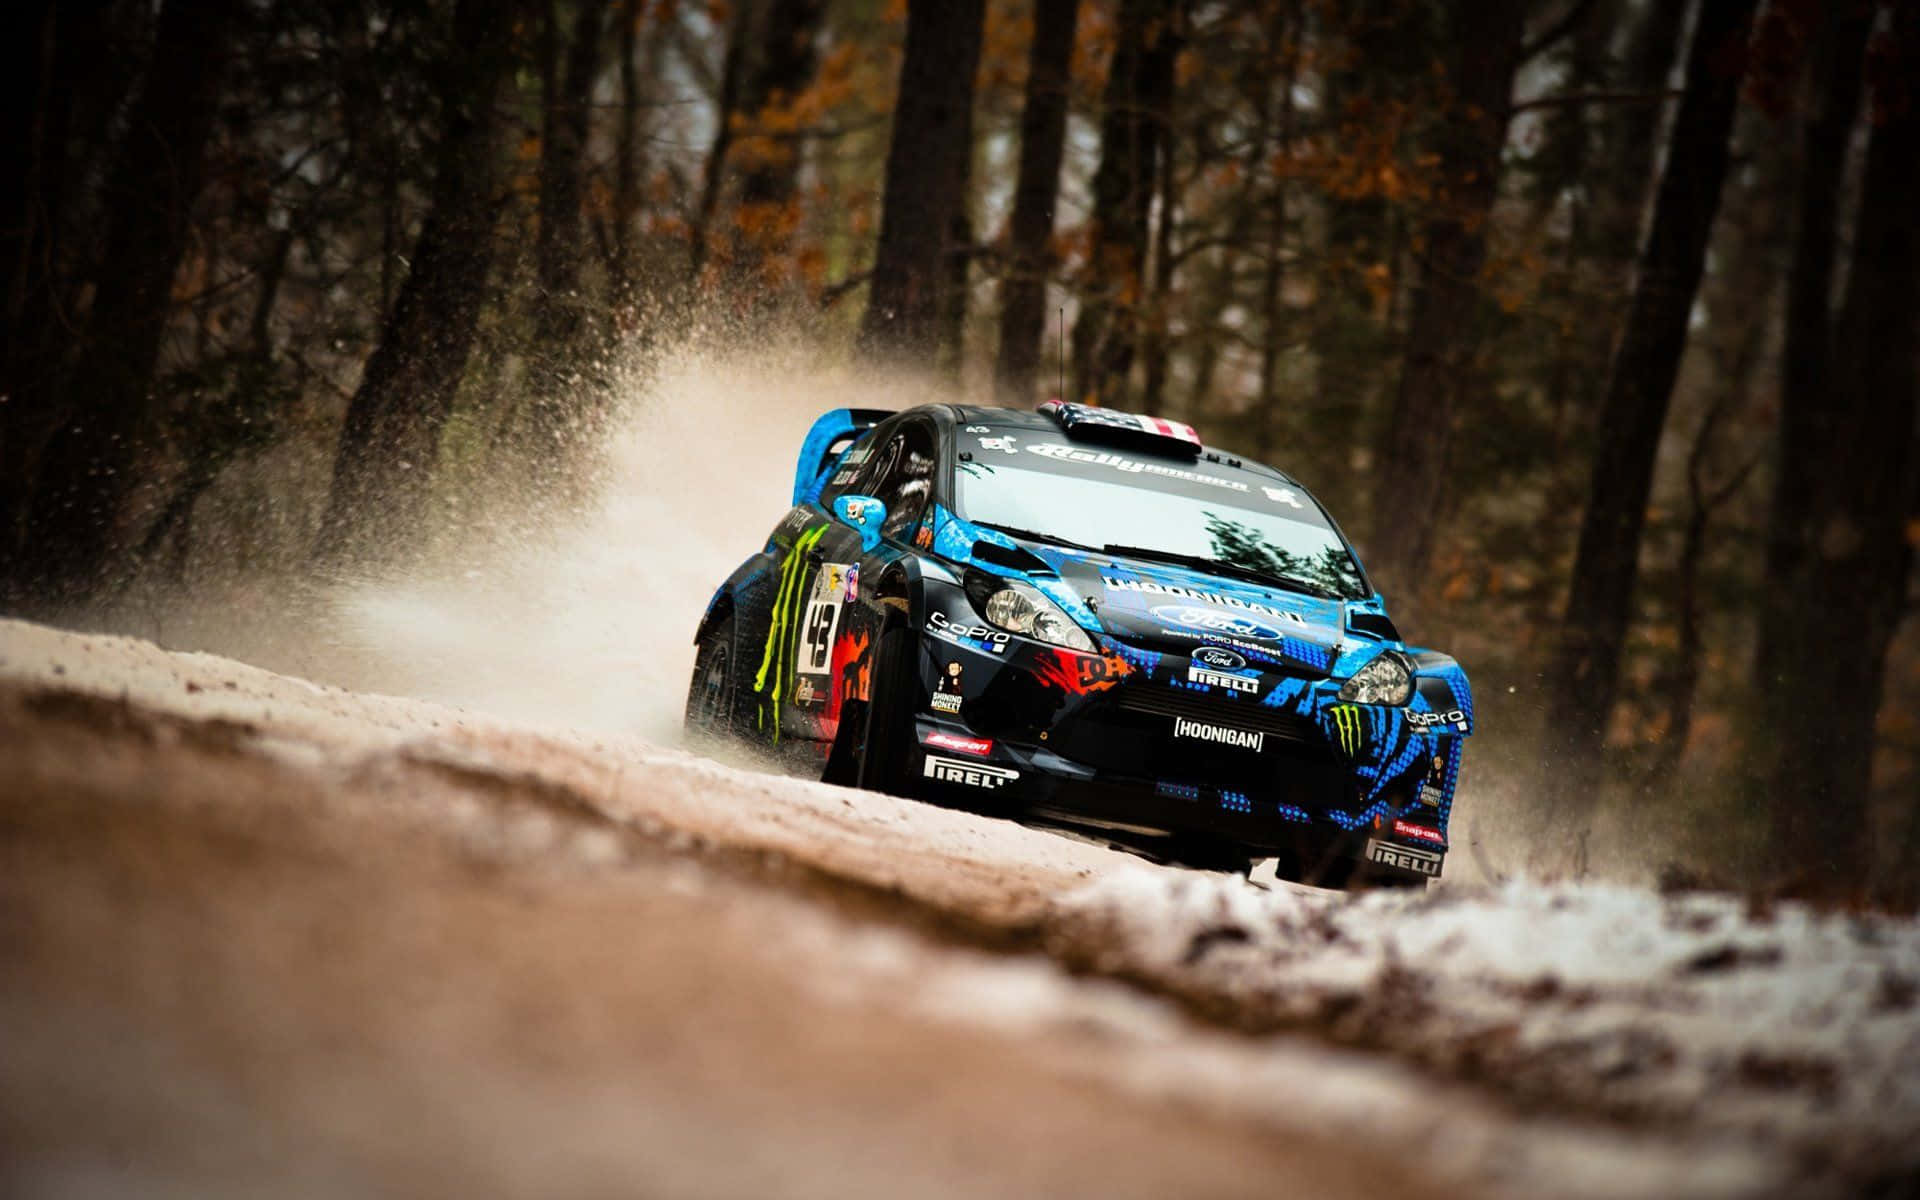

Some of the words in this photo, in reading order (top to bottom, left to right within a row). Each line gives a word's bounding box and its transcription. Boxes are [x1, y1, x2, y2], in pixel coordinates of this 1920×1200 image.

[930, 611, 1010, 643] GoPro
[1179, 606, 1257, 636] Ford
[807, 602, 835, 669] 43
[1202, 633, 1231, 645] FORD
[1203, 650, 1233, 667] Ford
[1188, 667, 1260, 694] PIRELLI
[1403, 710, 1465, 726] GoPro
[1366, 838, 1441, 875] PIRELLI
